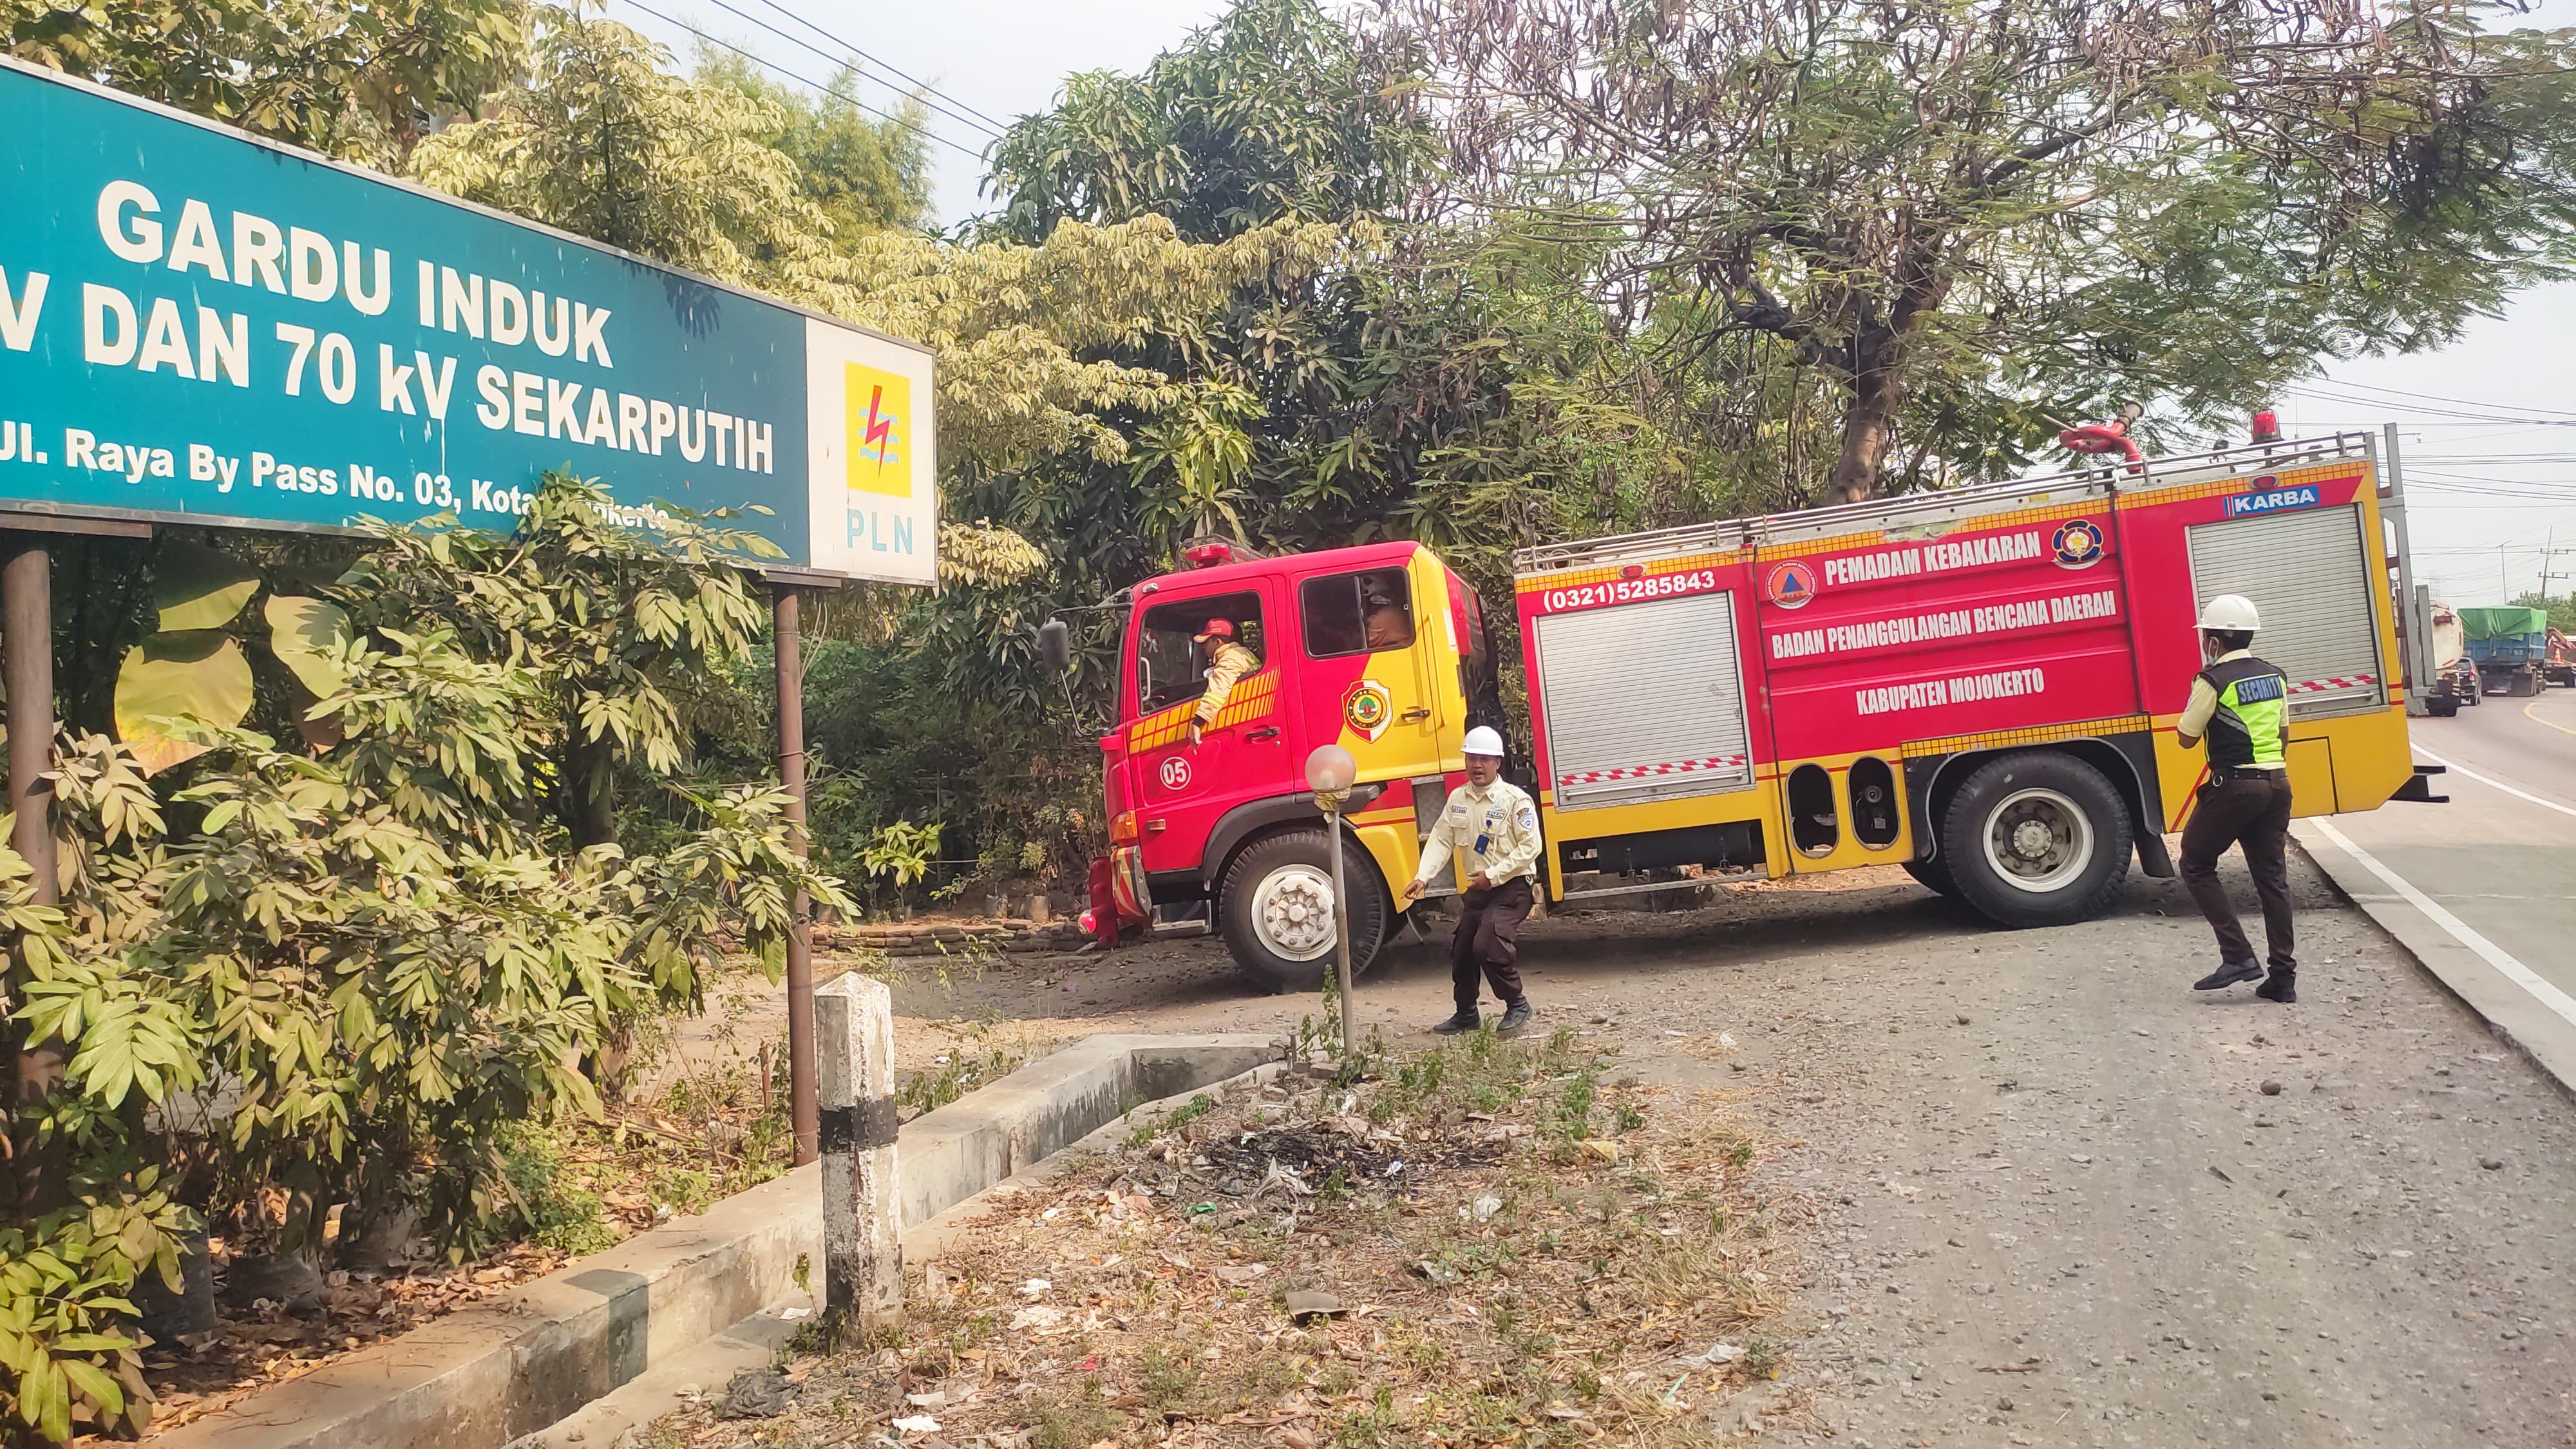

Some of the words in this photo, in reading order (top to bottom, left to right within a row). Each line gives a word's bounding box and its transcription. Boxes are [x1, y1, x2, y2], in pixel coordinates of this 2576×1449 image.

[97, 180, 391, 316] GARDU
[419, 260, 614, 368] INDUK
[82, 282, 249, 388] DAN
[276, 322, 357, 404] 70
[379, 343, 457, 420] kV
[476, 365, 773, 475] SEKARPUTIH
[0, 421, 48, 464] Jl.
[66, 428, 175, 484] Raya
[189, 443, 240, 493] By
[252, 451, 338, 495] Pass
[350, 464, 404, 502] No.
[415, 472, 462, 515] 03,
[472, 479, 537, 516] Kota
[2234, 489, 2316, 512] KARBA
[847, 508, 913, 554] PLN
[1824, 548, 1921, 585] PEMADAM
[1924, 531, 2041, 572] KEBAKARAN
[1543, 571, 1716, 612] (0321)5285843
[1772, 629, 1825, 659] BADAN
[1827, 610, 1972, 652] PENANGGULANGAN
[1973, 600, 2049, 634] BENCANA
[2050, 590, 2117, 622] DAERAH
[1856, 680, 1947, 715] KABUPATEN
[1949, 667, 2045, 703] MOJOKERTO
[2238, 676, 2282, 703] SECURITY
[1163, 761, 1187, 784] 05
